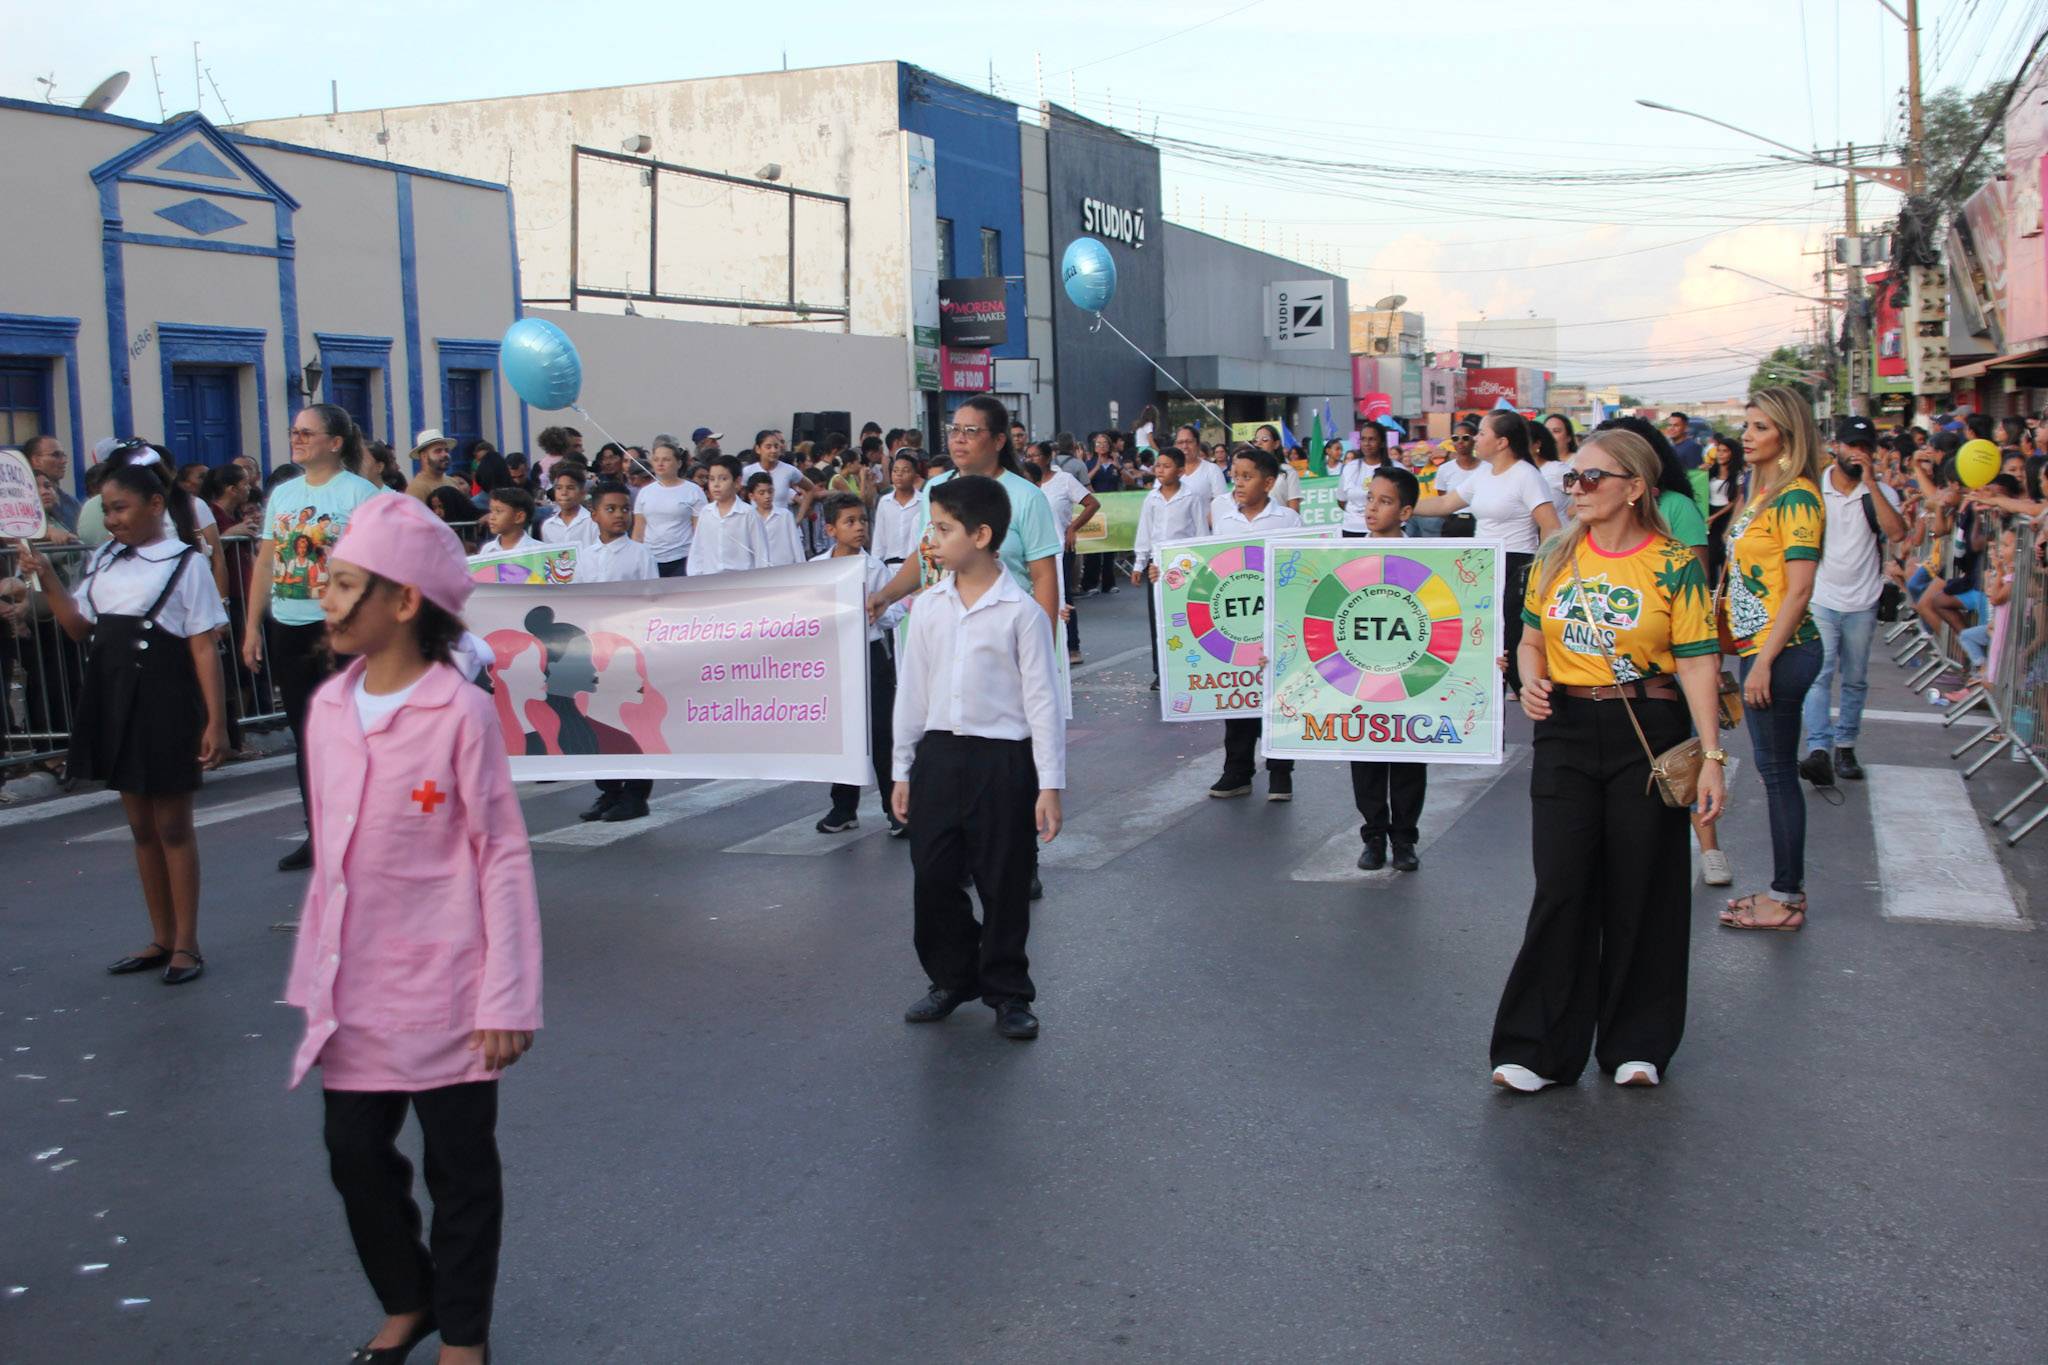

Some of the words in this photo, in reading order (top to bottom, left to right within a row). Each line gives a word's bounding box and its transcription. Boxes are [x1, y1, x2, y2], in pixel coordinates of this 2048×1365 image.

[1083, 197, 1133, 243] STUDIO
[953, 300, 1005, 314] MORENA
[976, 311, 1007, 322] MAKES
[1279, 292, 1288, 341] STUDIO
[1230, 572, 1261, 582] Tempo
[1225, 595, 1264, 618] ETA
[1337, 608, 1349, 642] Escola
[1347, 595, 1363, 609] em
[1362, 588, 1402, 598] Tempo
[1402, 594, 1430, 642] Ampliado
[646, 613, 737, 642] Parabéns
[739, 619, 754, 639] a
[758, 613, 821, 639] todas
[1354, 617, 1412, 641] ETA
[701, 663, 726, 682] as
[731, 655, 826, 680] mulheres
[686, 696, 828, 723] batalhadoras!
[1302, 705, 1462, 744] MÚSICA
